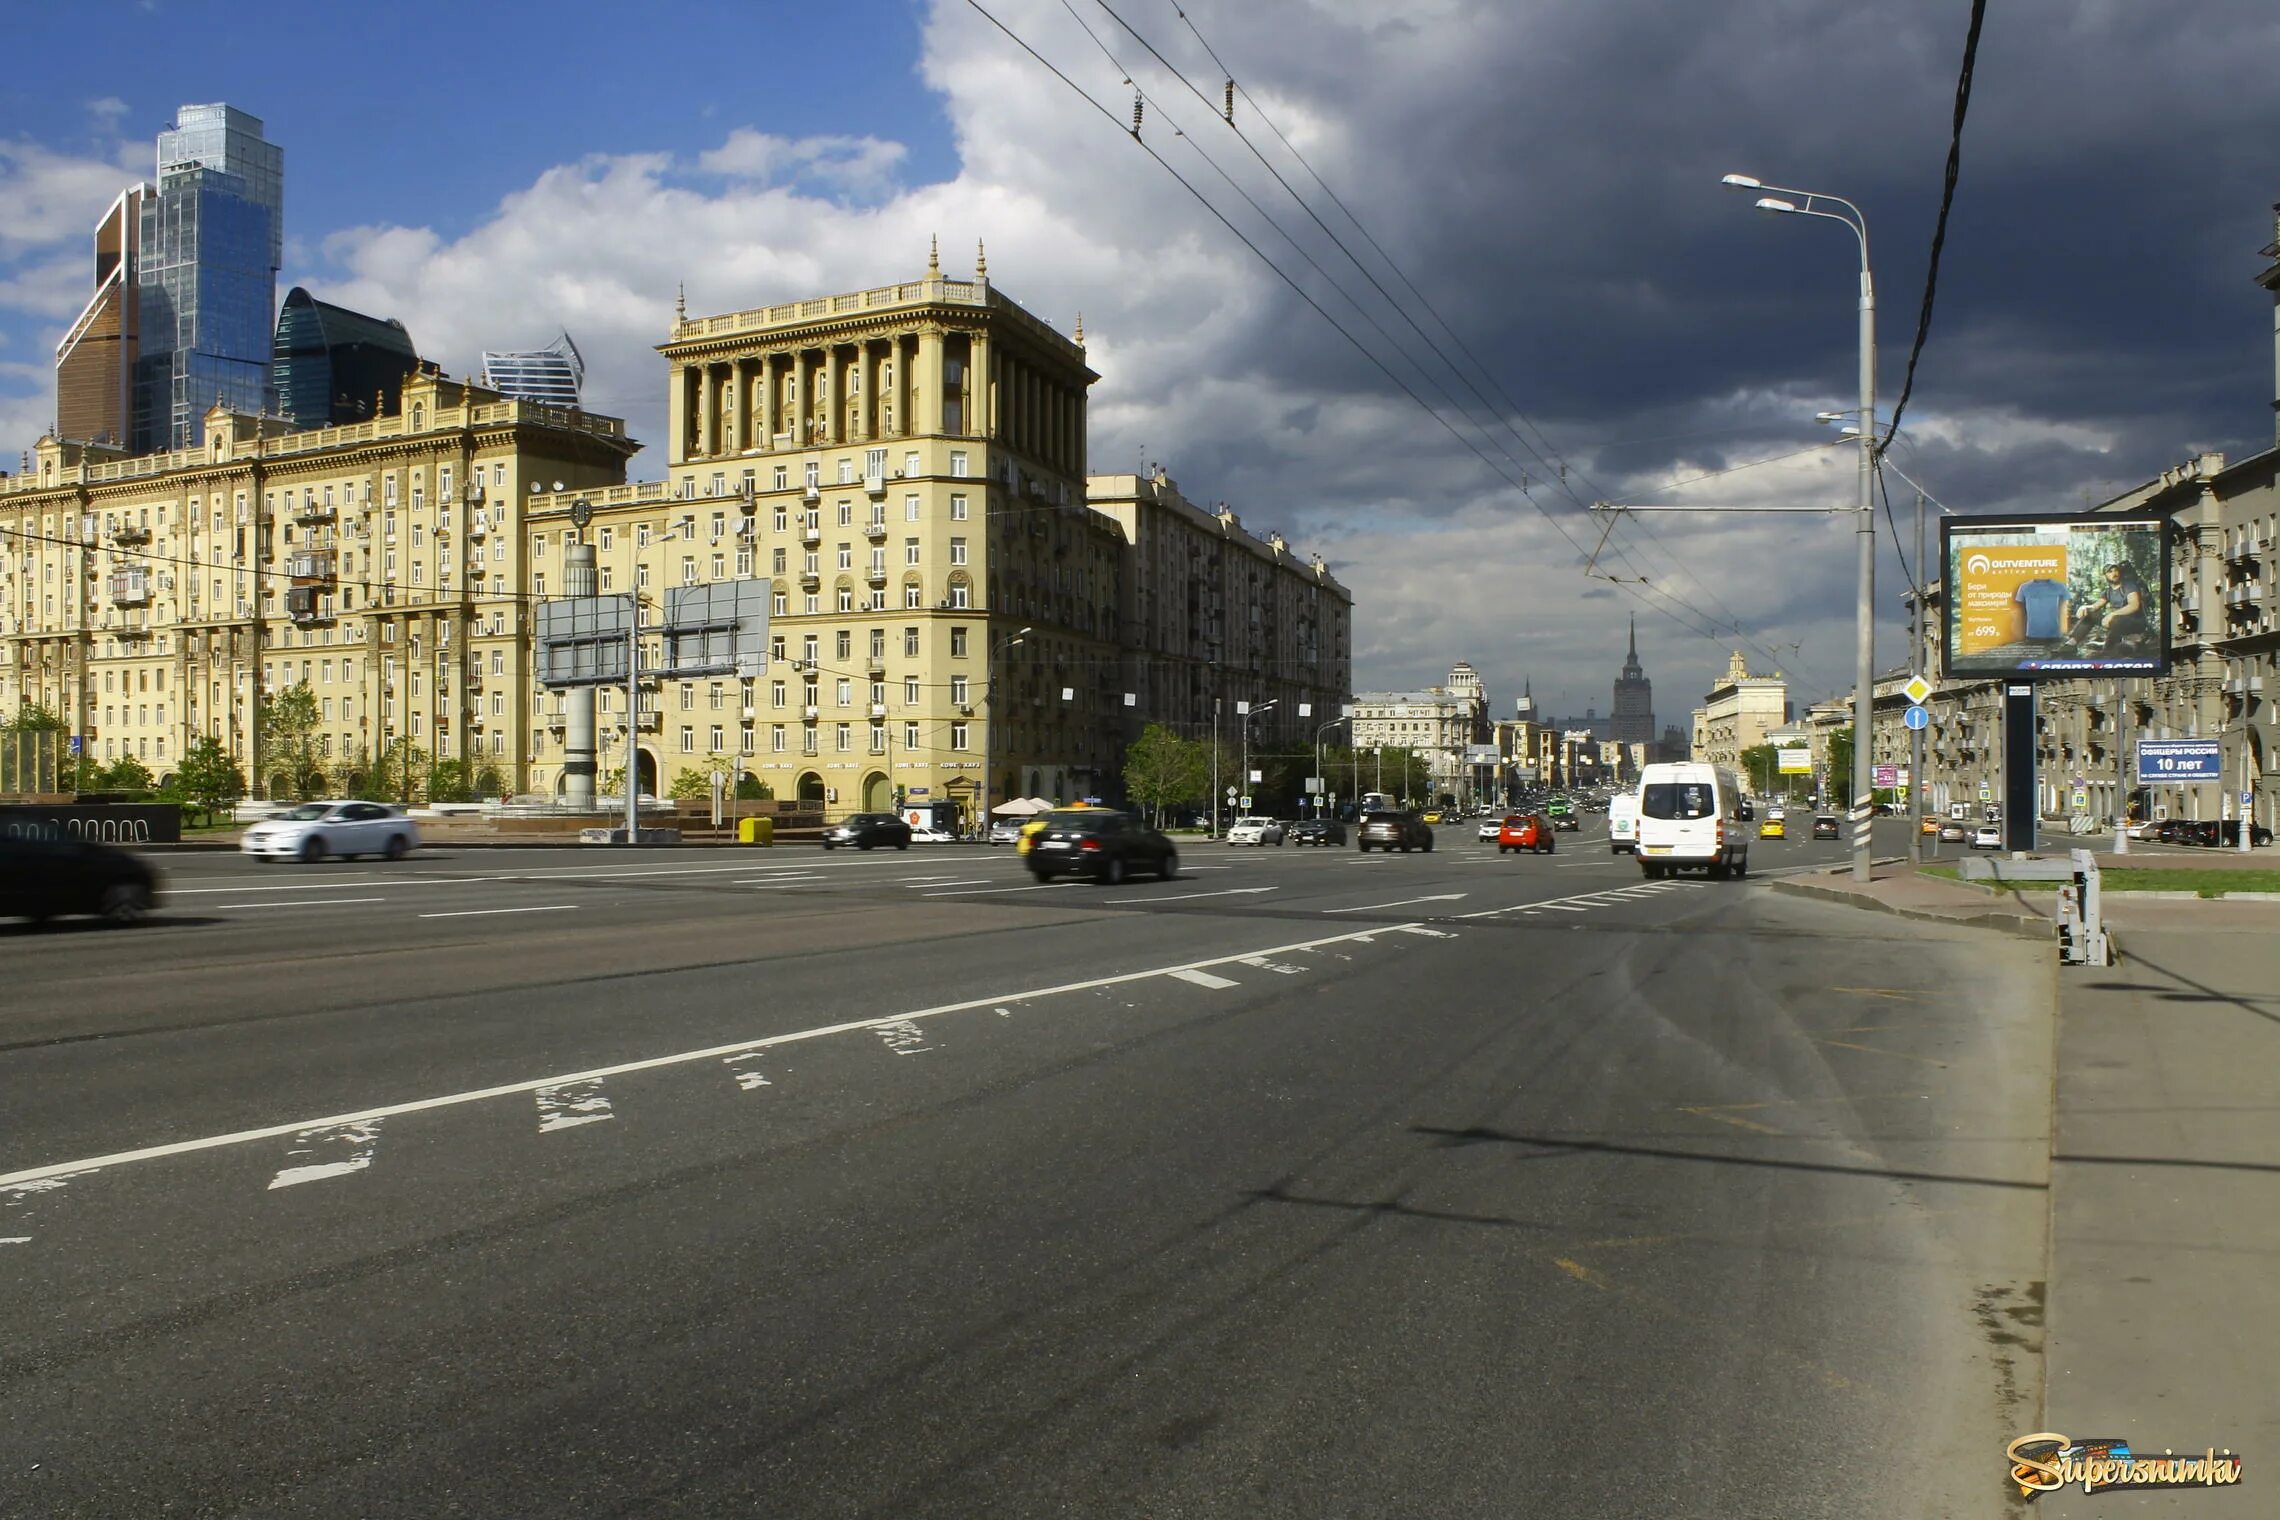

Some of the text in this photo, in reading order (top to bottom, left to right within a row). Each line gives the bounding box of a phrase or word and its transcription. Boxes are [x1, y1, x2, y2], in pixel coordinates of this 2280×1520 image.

[1991, 559, 2059, 568] OUTVENTURE
[1975, 625, 1996, 637] 699
[2140, 747, 2219, 756] ОФИЦЕРЫ РОССИИ
[2156, 758, 2204, 771] 10 лет
[2243, 793, 2250, 804] P
